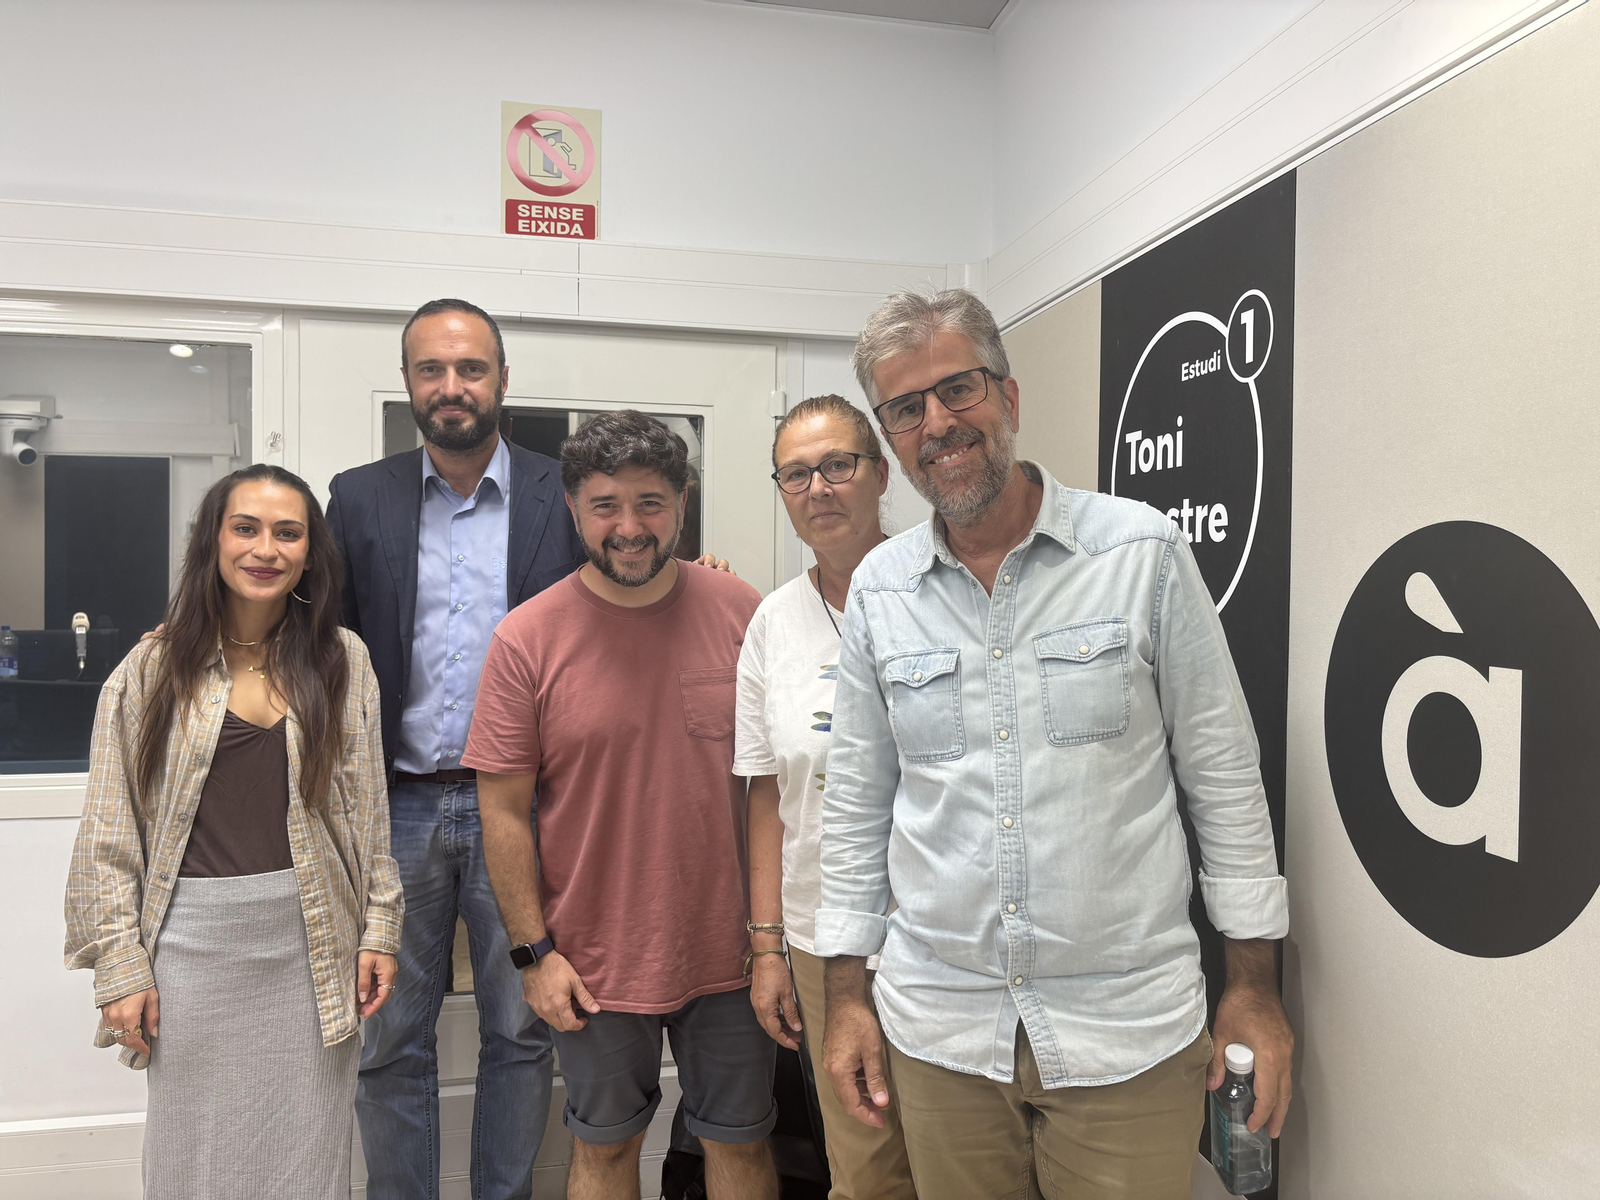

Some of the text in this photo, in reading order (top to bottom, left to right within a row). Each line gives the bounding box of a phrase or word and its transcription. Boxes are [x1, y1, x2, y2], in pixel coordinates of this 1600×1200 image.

[517, 204, 584, 221] SENSE
[518, 219, 584, 236] EIXIDA
[1181, 308, 1255, 382] Estudi 1
[1125, 415, 1184, 475] Toni
[1166, 498, 1229, 543] tre
[1381, 571, 1523, 863] à
